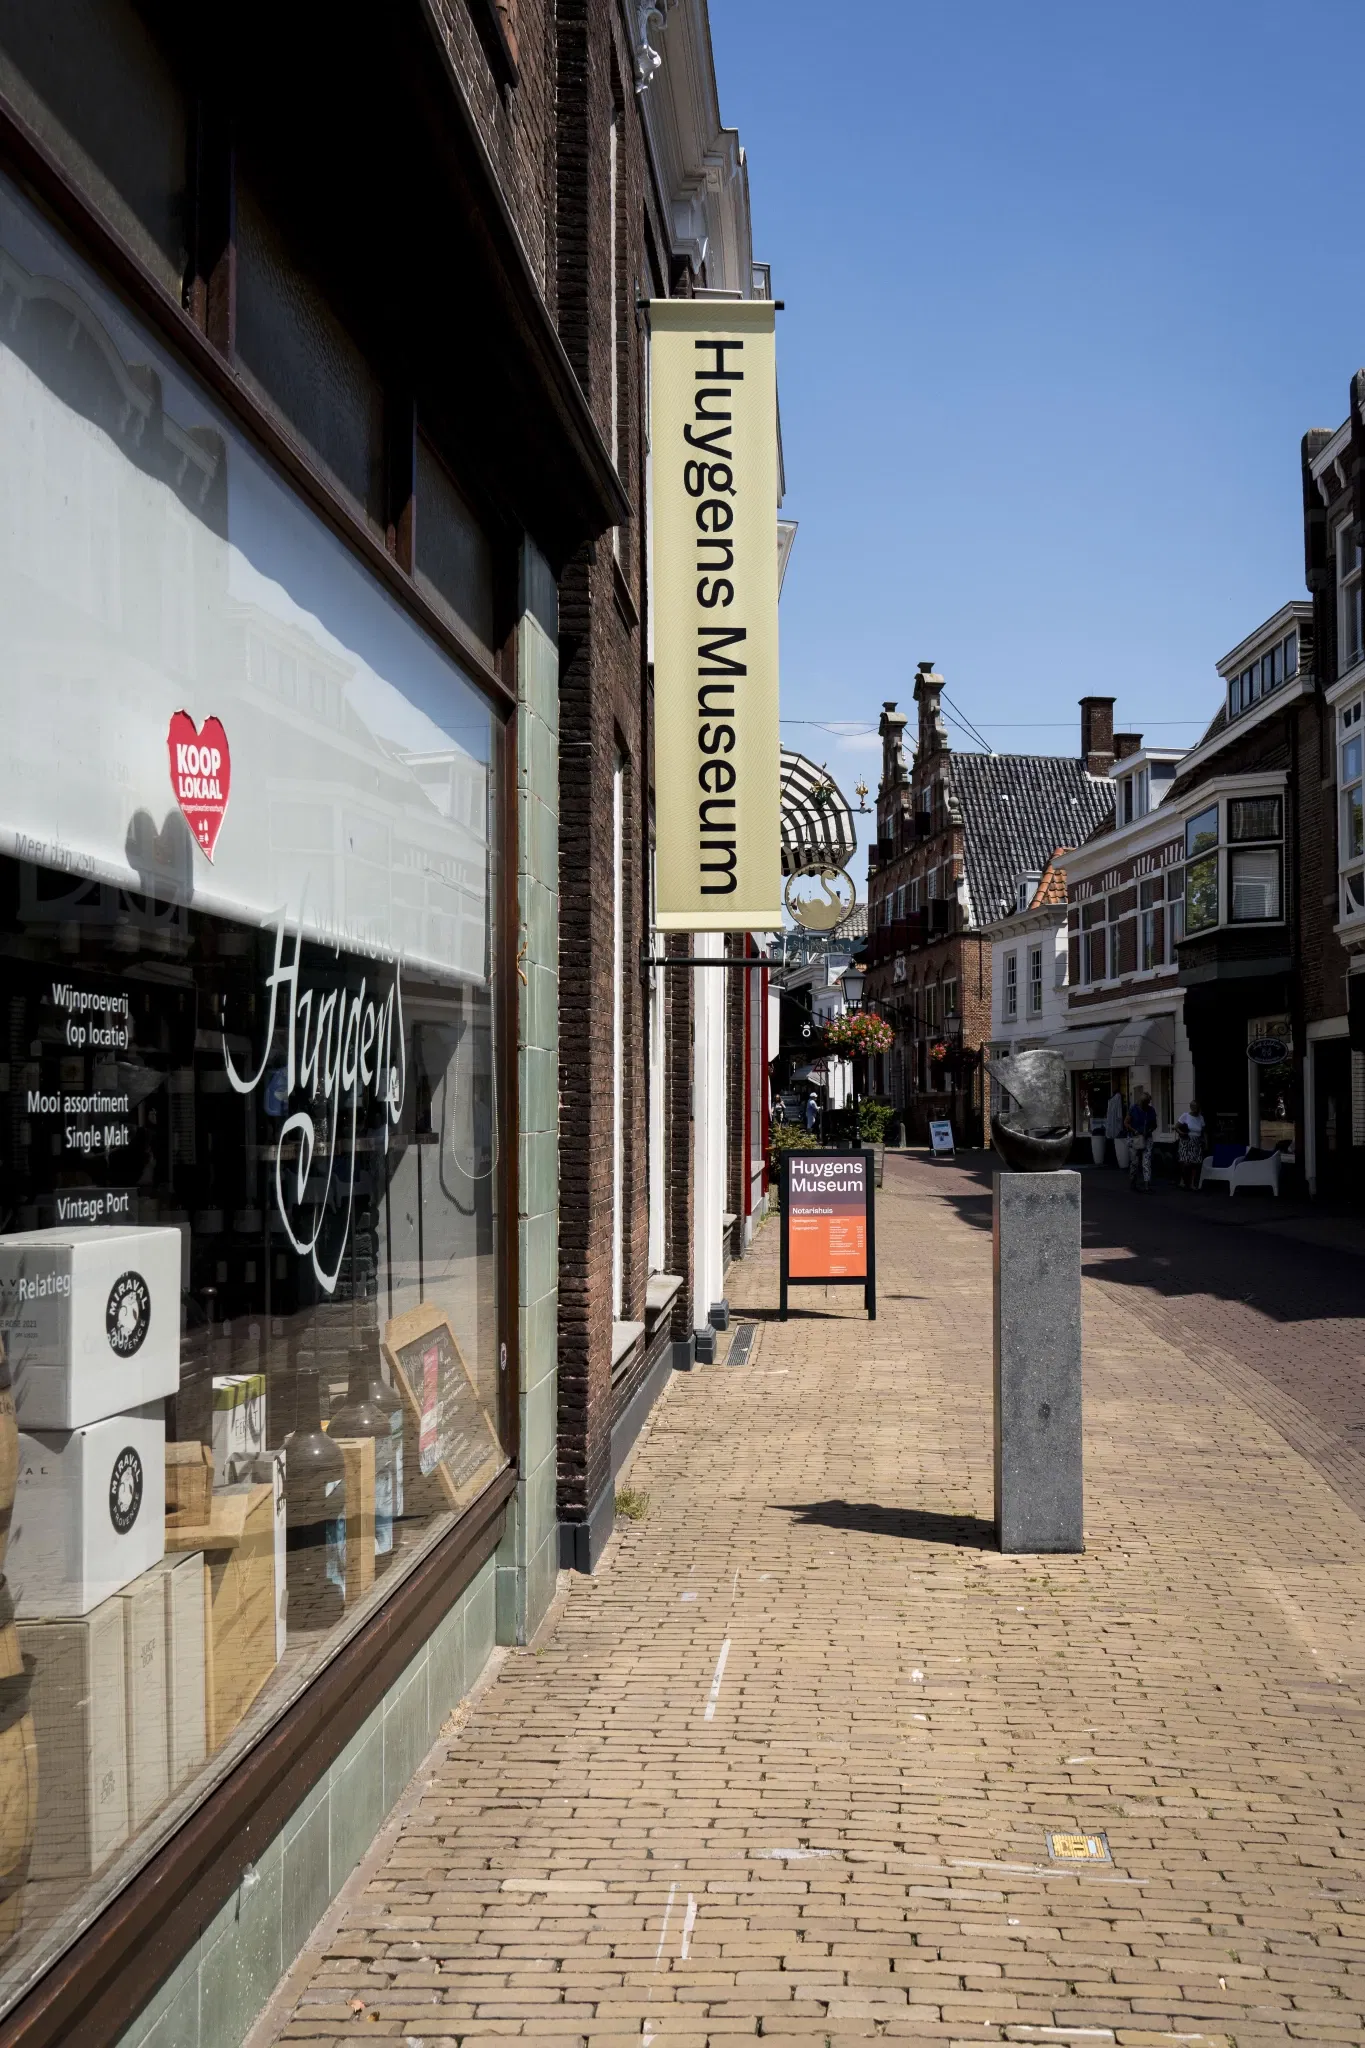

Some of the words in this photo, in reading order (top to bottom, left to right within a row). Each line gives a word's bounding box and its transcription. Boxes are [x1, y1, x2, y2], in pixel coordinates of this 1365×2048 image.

[683, 339, 744, 608] Huygens
[176, 743, 221, 777] KOOP
[697, 627, 747, 894] Museum
[178, 775, 223, 799] LOKAAL
[51, 982, 129, 1019] Wijnproeverij
[66, 1019, 86, 1048] (op
[89, 1021, 129, 1050] locatie)
[222, 872, 405, 1294] Huygens
[27, 1091, 61, 1112] Mooi
[64, 1091, 129, 1113] assortiment
[66, 1125, 101, 1153] Single
[104, 1124, 129, 1146] Malt
[791, 1160, 863, 1178] Huygens
[791, 1178, 863, 1192] Museum
[57, 1197, 104, 1222] Vintage
[106, 1192, 129, 1214] Port
[792, 1207, 834, 1215] Notarishuis
[109, 1279, 148, 1316] MIRAVAL
[111, 1453, 142, 1495] MIRAVAL
[112, 1492, 141, 1527] PROVENCE
